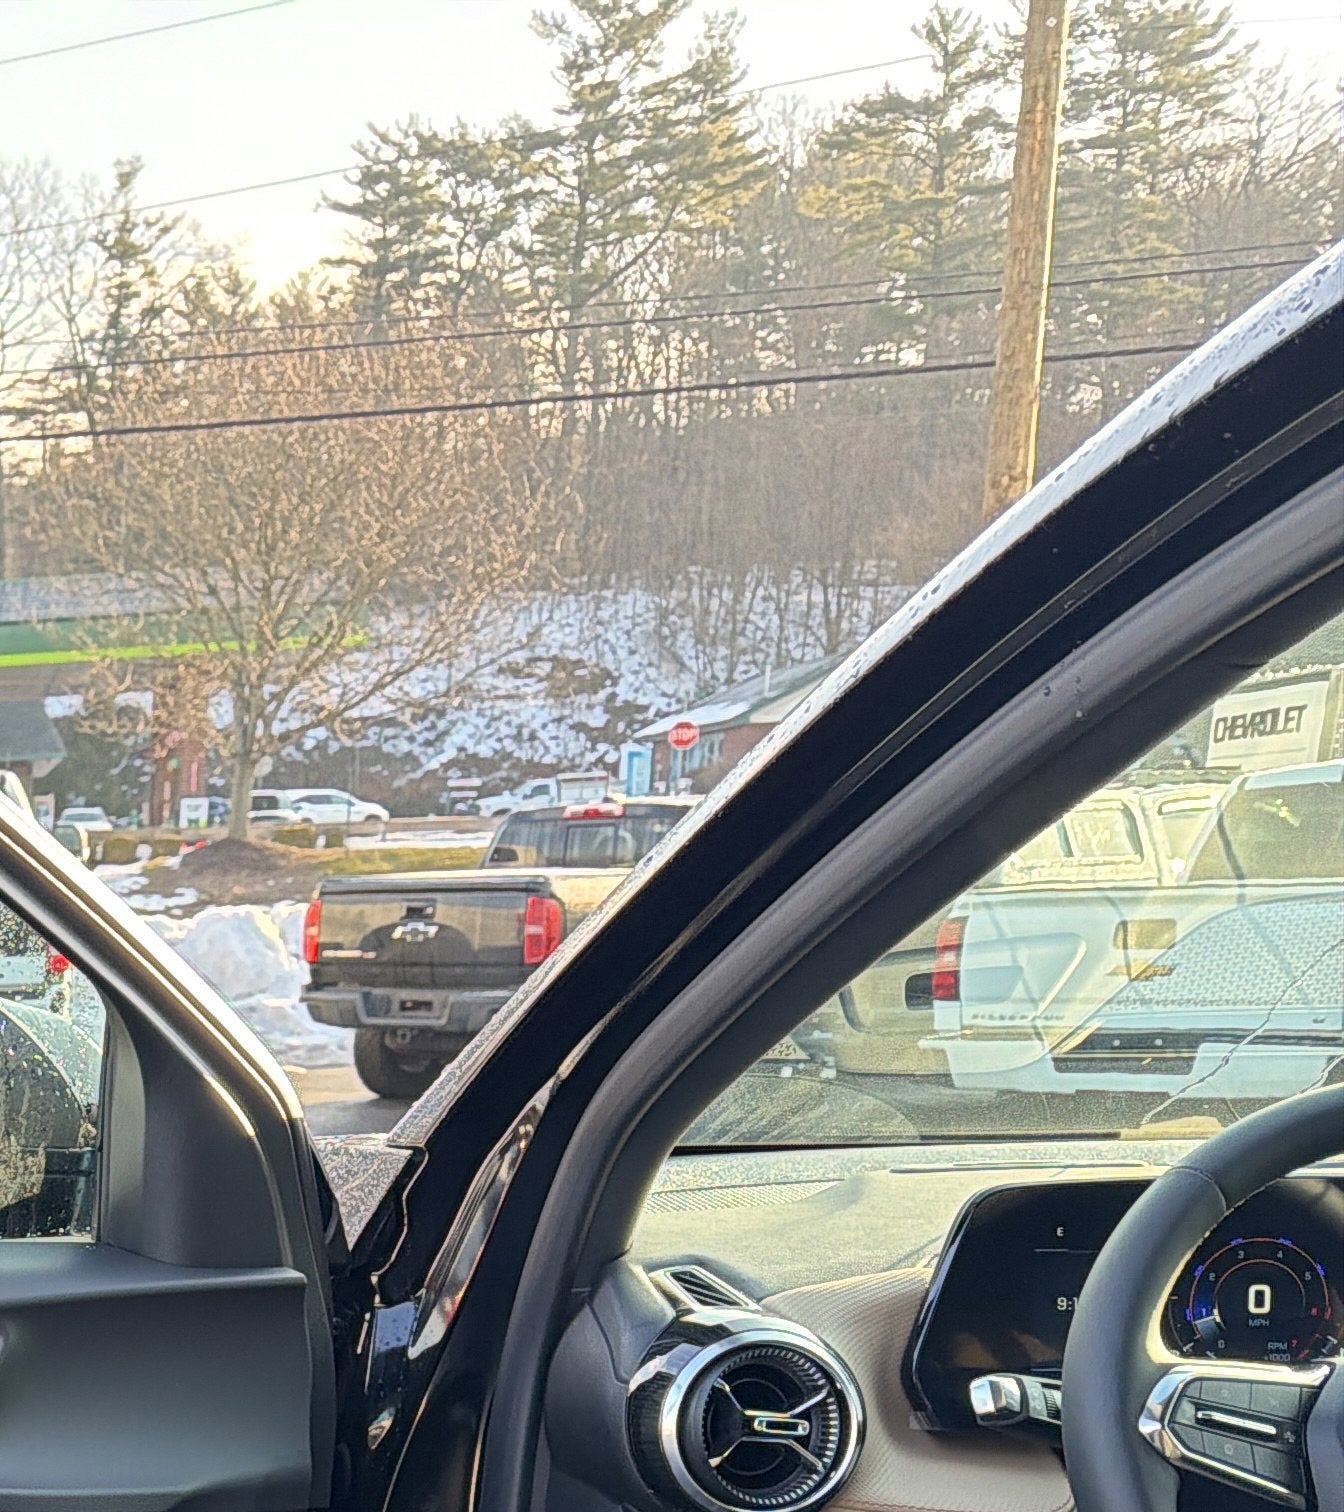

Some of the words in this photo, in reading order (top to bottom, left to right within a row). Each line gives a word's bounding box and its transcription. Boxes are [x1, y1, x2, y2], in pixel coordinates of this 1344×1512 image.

[1213, 704, 1308, 744] CHEVROLET
[1276, 1250, 1284, 1259] 4
[1248, 1284, 1271, 1314] 0
[1248, 1319, 1270, 1327] MPH
[1267, 1342, 1288, 1350] RPM
